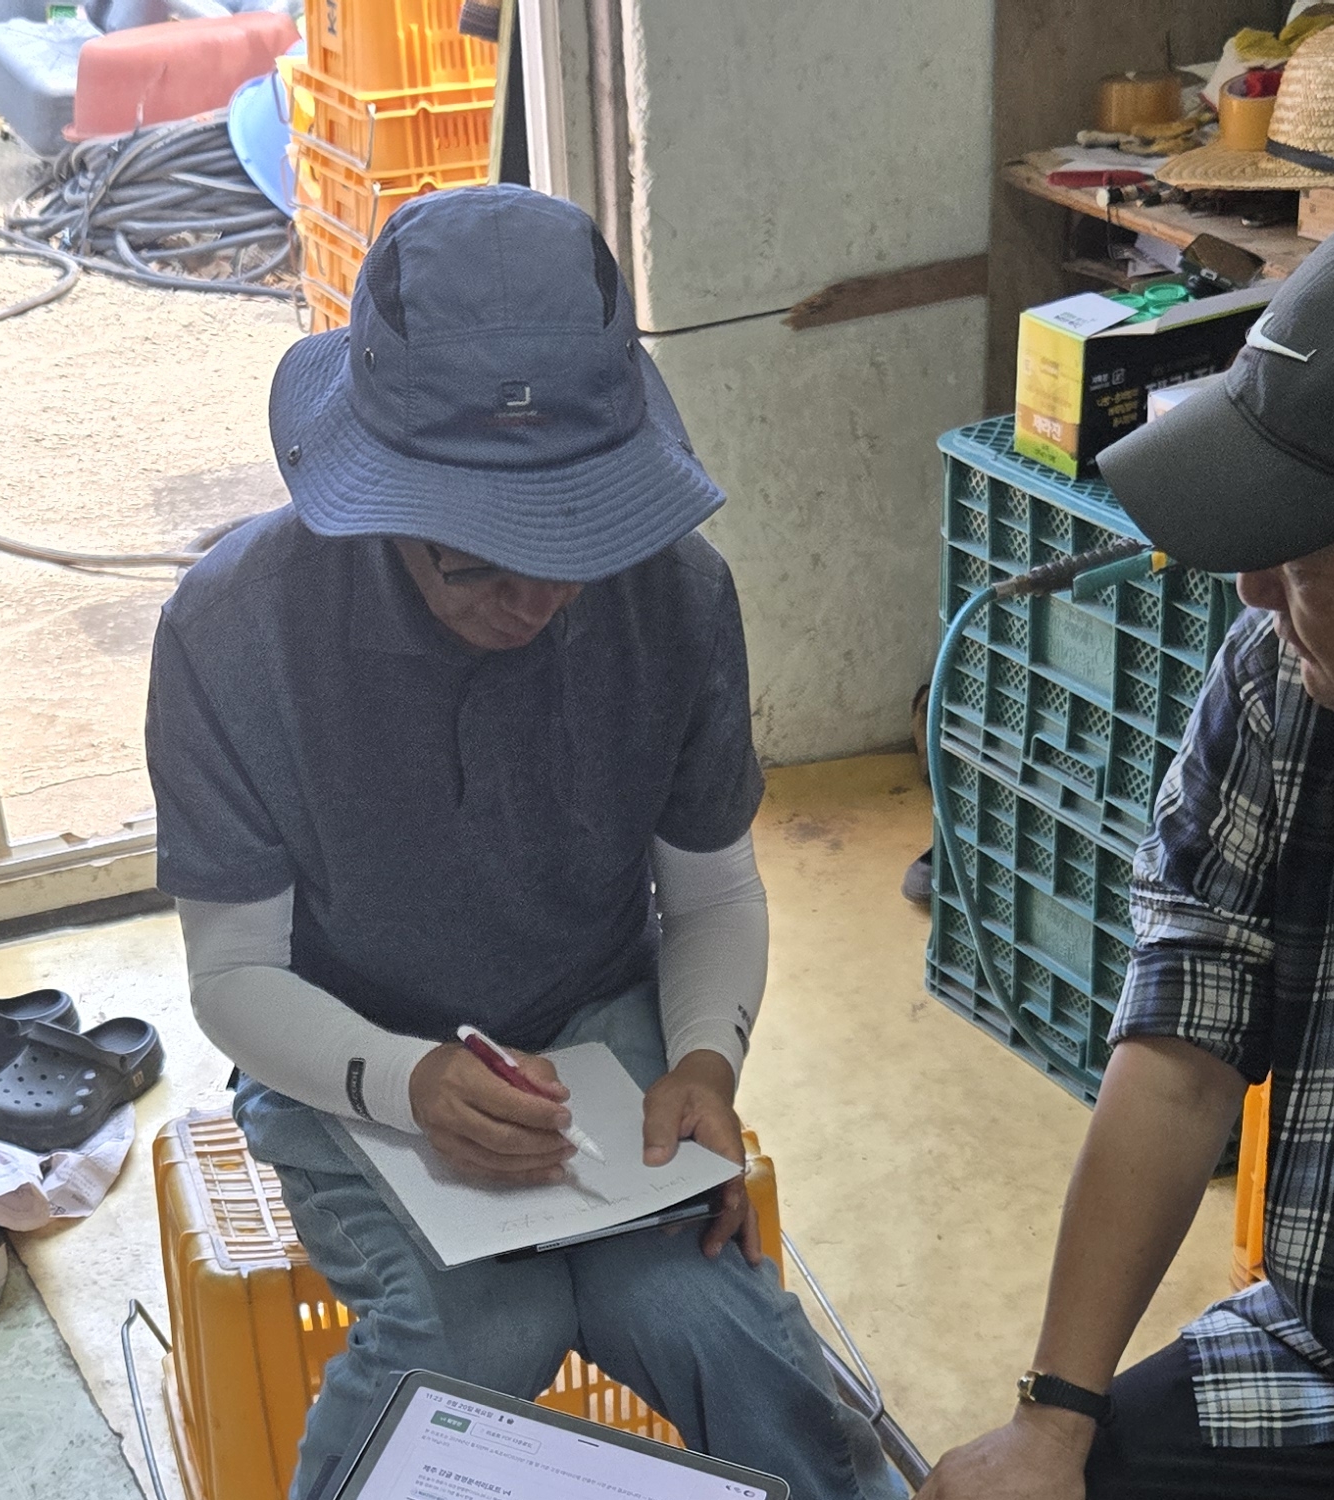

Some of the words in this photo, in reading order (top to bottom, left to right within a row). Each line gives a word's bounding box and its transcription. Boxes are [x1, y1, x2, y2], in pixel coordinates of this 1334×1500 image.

[424, 1392, 444, 1403] 11:23
[456, 1402, 475, 1412] 20일
[472, 1407, 494, 1418] 목요일
[421, 1463, 438, 1474] 제주
[436, 1468, 454, 1479] 감귤
[452, 1473, 502, 1494] 경영분석리포트
[501, 1488, 512, 1497] v4
